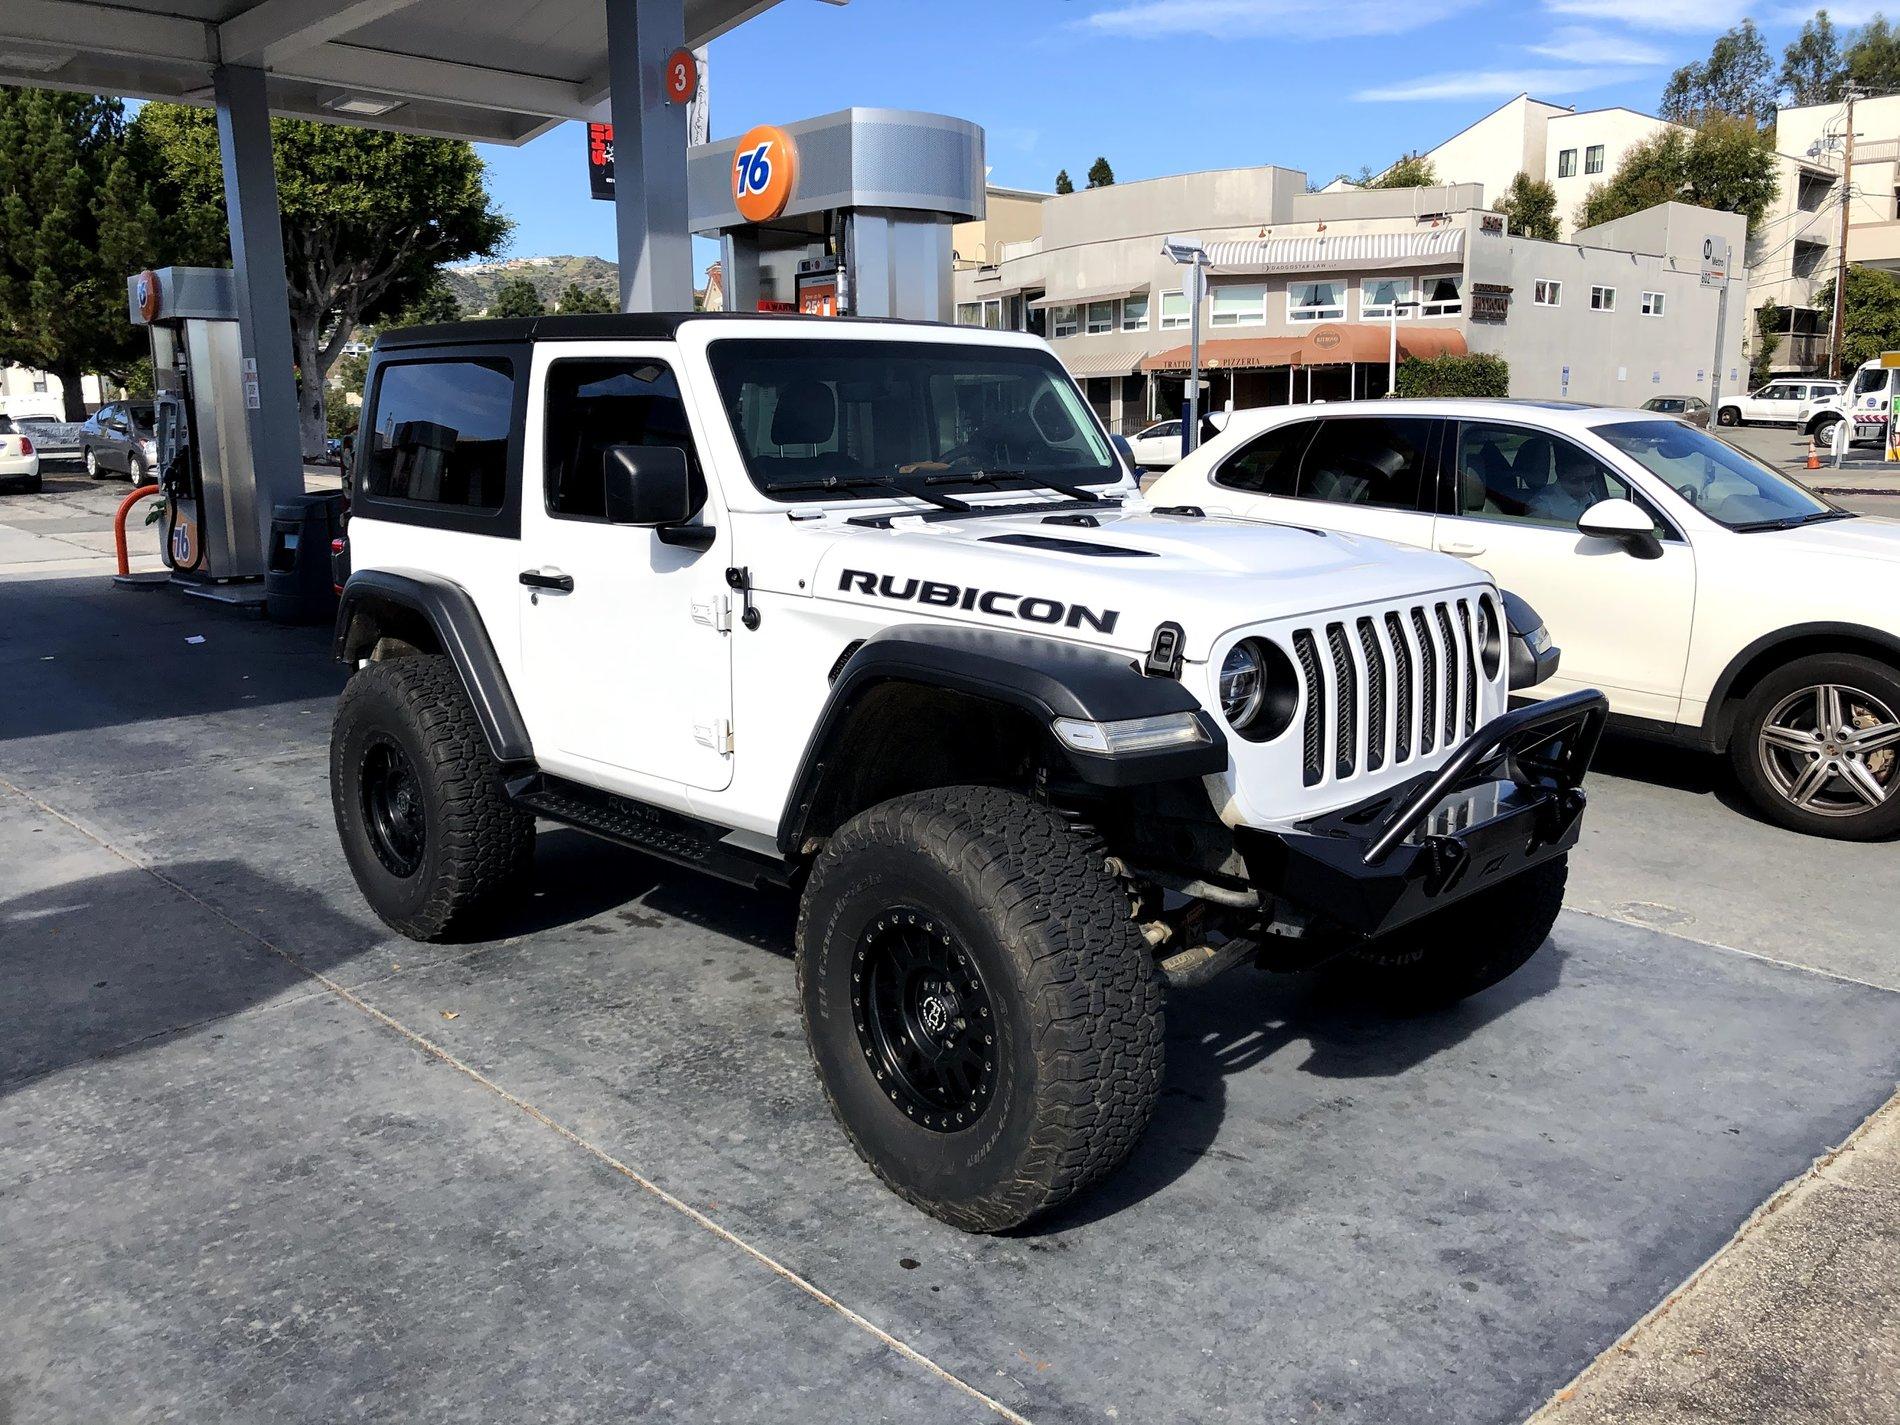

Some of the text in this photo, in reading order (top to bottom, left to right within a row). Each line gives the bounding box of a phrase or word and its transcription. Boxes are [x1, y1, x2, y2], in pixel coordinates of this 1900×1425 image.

[675, 63, 687, 92] 3
[736, 141, 773, 198] 76
[1164, 360, 1204, 369] TRATTOA
[1223, 358, 1260, 367] PIZZERIA
[172, 523, 190, 560] 76
[838, 568, 1120, 635] RUBICON
